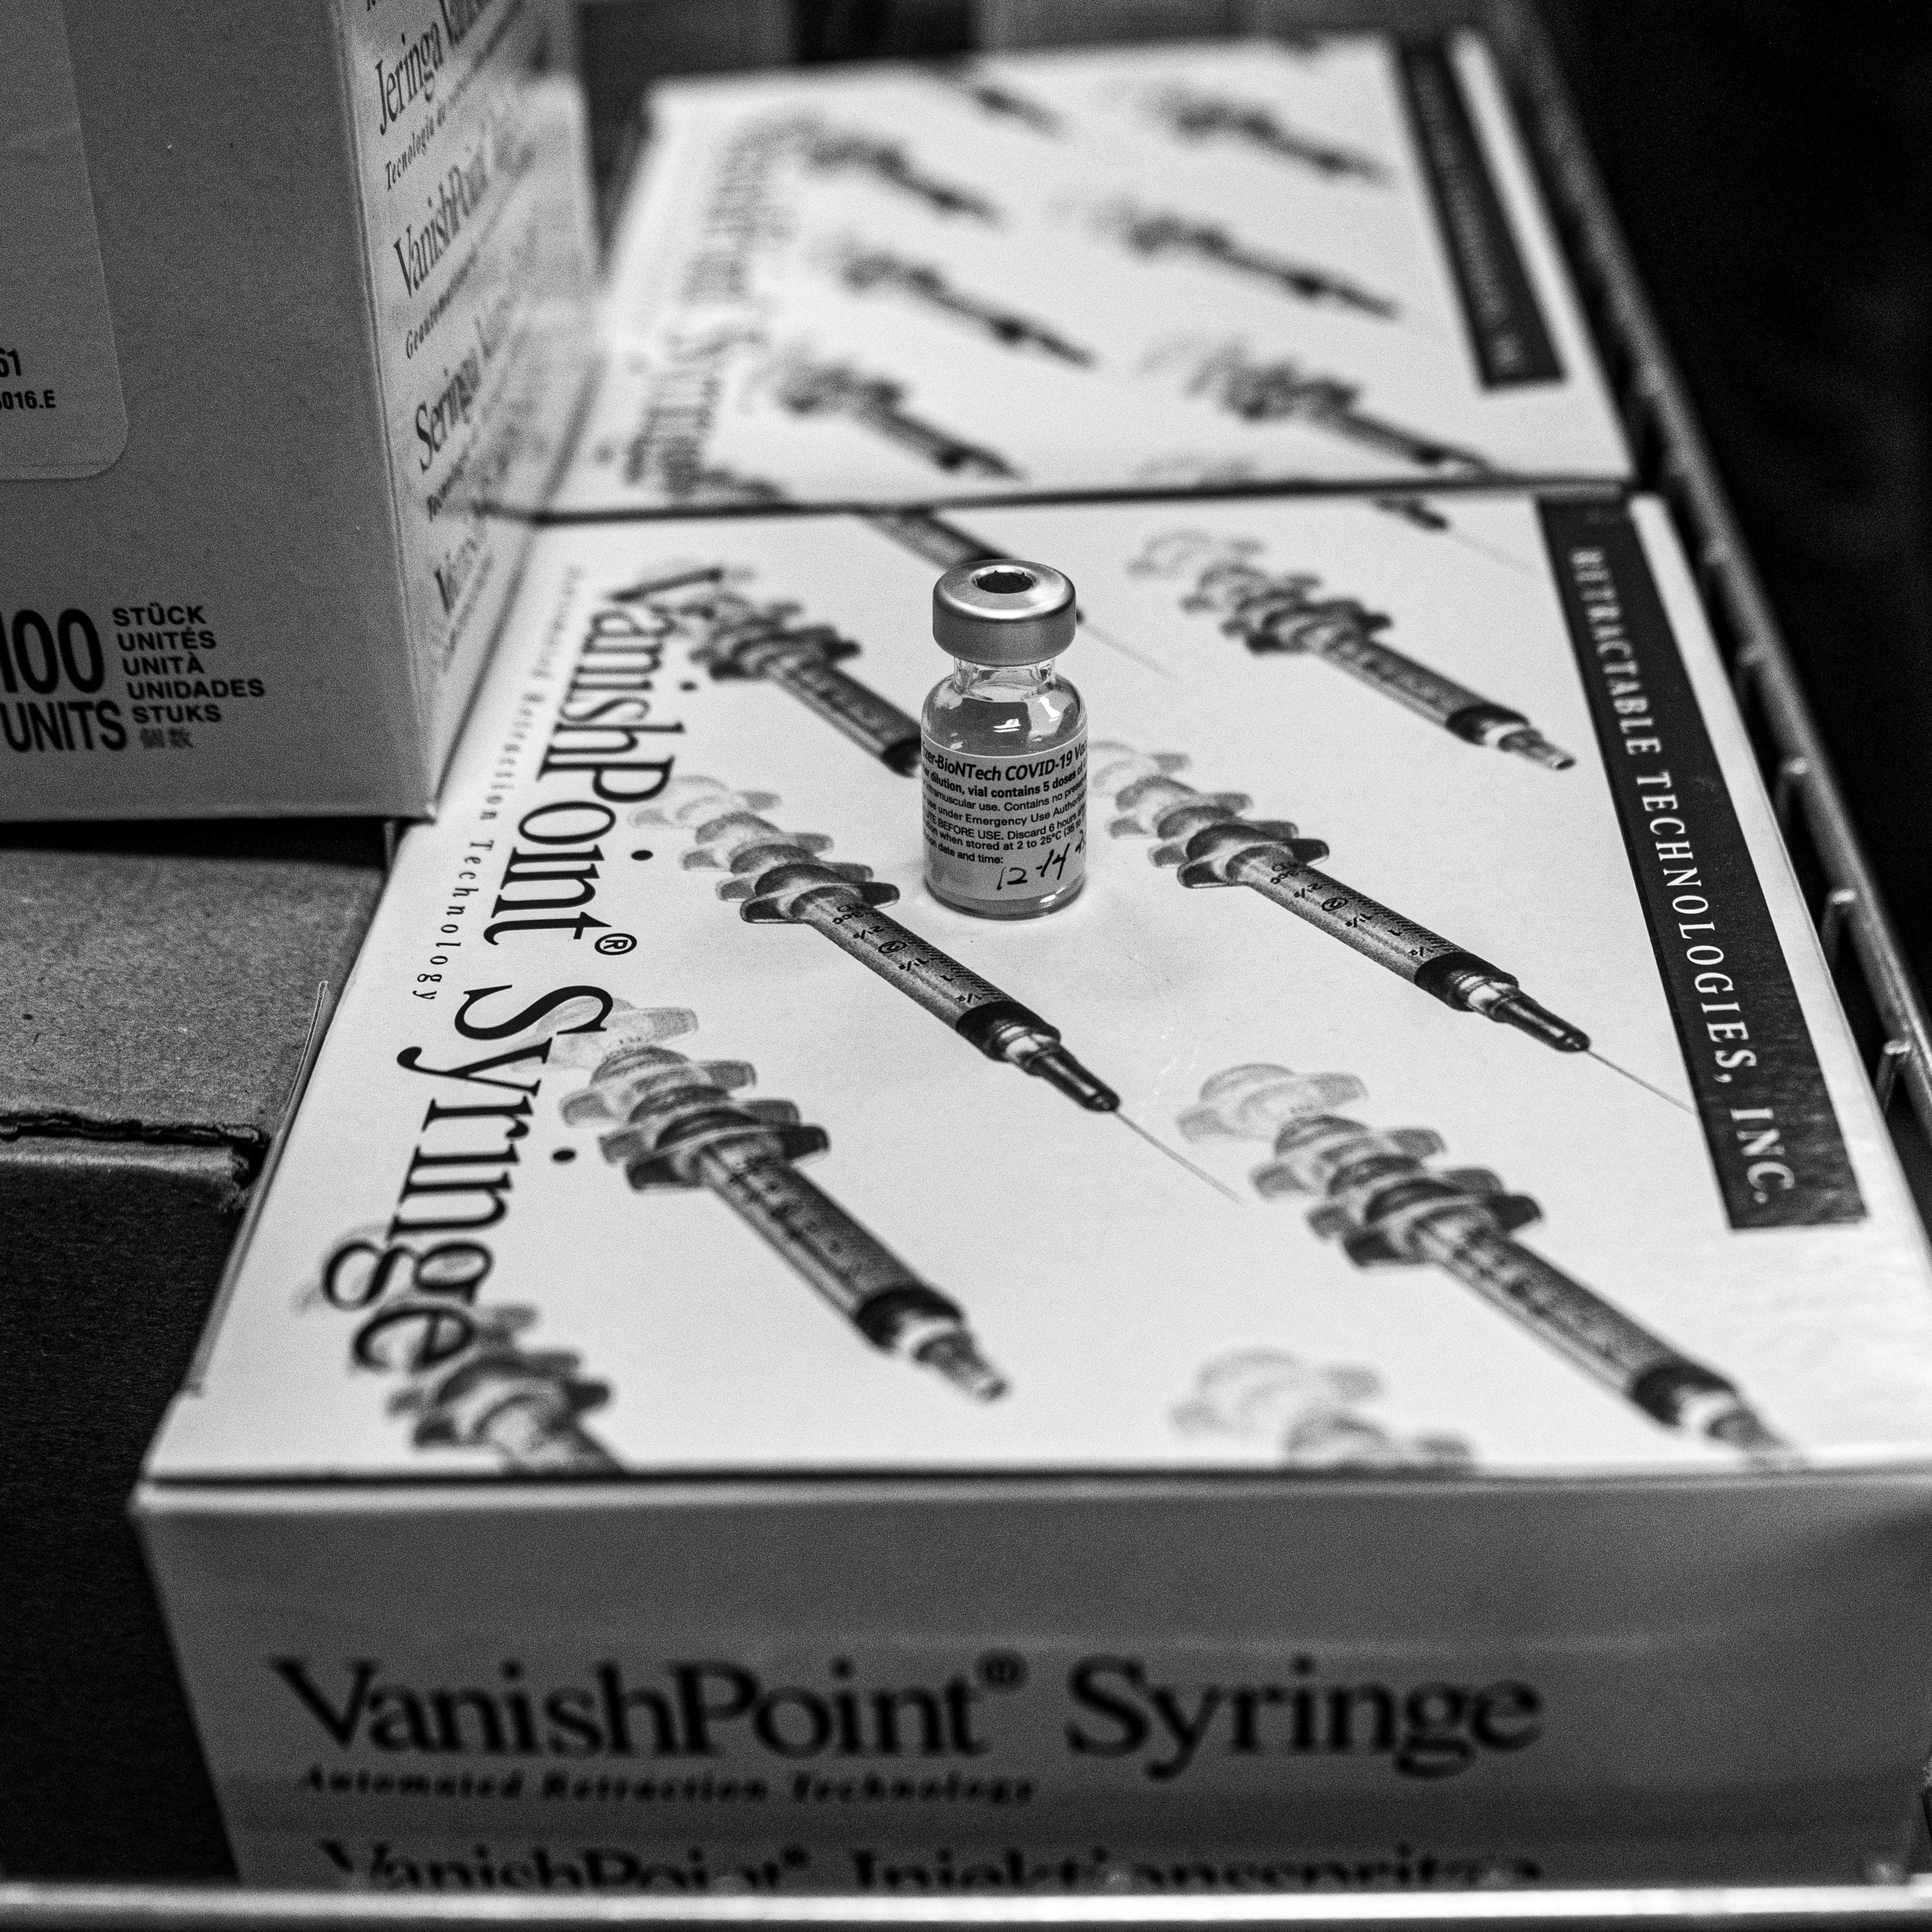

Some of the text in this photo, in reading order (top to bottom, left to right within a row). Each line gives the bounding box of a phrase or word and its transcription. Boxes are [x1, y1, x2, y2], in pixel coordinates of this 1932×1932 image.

[0, 390, 56, 410] 016.E
[112, 602, 207, 627] STÜCK
[0, 608, 105, 694] 100
[117, 627, 217, 651] UNITÉS
[121, 651, 205, 676] UNITÀ
[127, 678, 266, 700] UNIDADES
[0, 700, 127, 752] UNITS
[131, 704, 223, 724] STUKS
[922, 746, 1001, 781] zer-BioNTech
[1005, 750, 1072, 781] COVID-19
[930, 771, 965, 795] dilution,
[968, 785, 987, 797] vial
[991, 785, 1040, 798] contains
[1043, 781, 1050, 792] 5
[1052, 771, 1076, 789] doses
[979, 803, 1000, 811] use.
[1004, 798, 1049, 811] Contains
[1052, 793, 1063, 803] no
[938, 806, 963, 820] under
[965, 814, 1027, 827] Emergency
[1030, 812, 1050, 823] Use
[938, 818, 975, 838] BEFORE
[978, 830, 1003, 840] USE.
[1007, 826, 1046, 840] Discard
[1049, 823, 1055, 832] 6
[1057, 813, 1076, 828] hours
[940, 831, 963, 846] when
[965, 840, 1000, 850] stored
[1003, 842, 1014, 850] at
[1017, 841, 1023, 850] 2
[1026, 840, 1037, 849] to
[938, 843, 955, 857] date
[957, 852, 975, 862] and
[978, 854, 1003, 864] time:
[413, 839, 495, 1001] Technology
[1636, 771, 1758, 1084] TECHNOLOGIES,
[1729, 1107, 1796, 1204] INC.
[322, 984, 577, 1374] Syringe
[1066, 1652, 1545, 1781] Syringe
